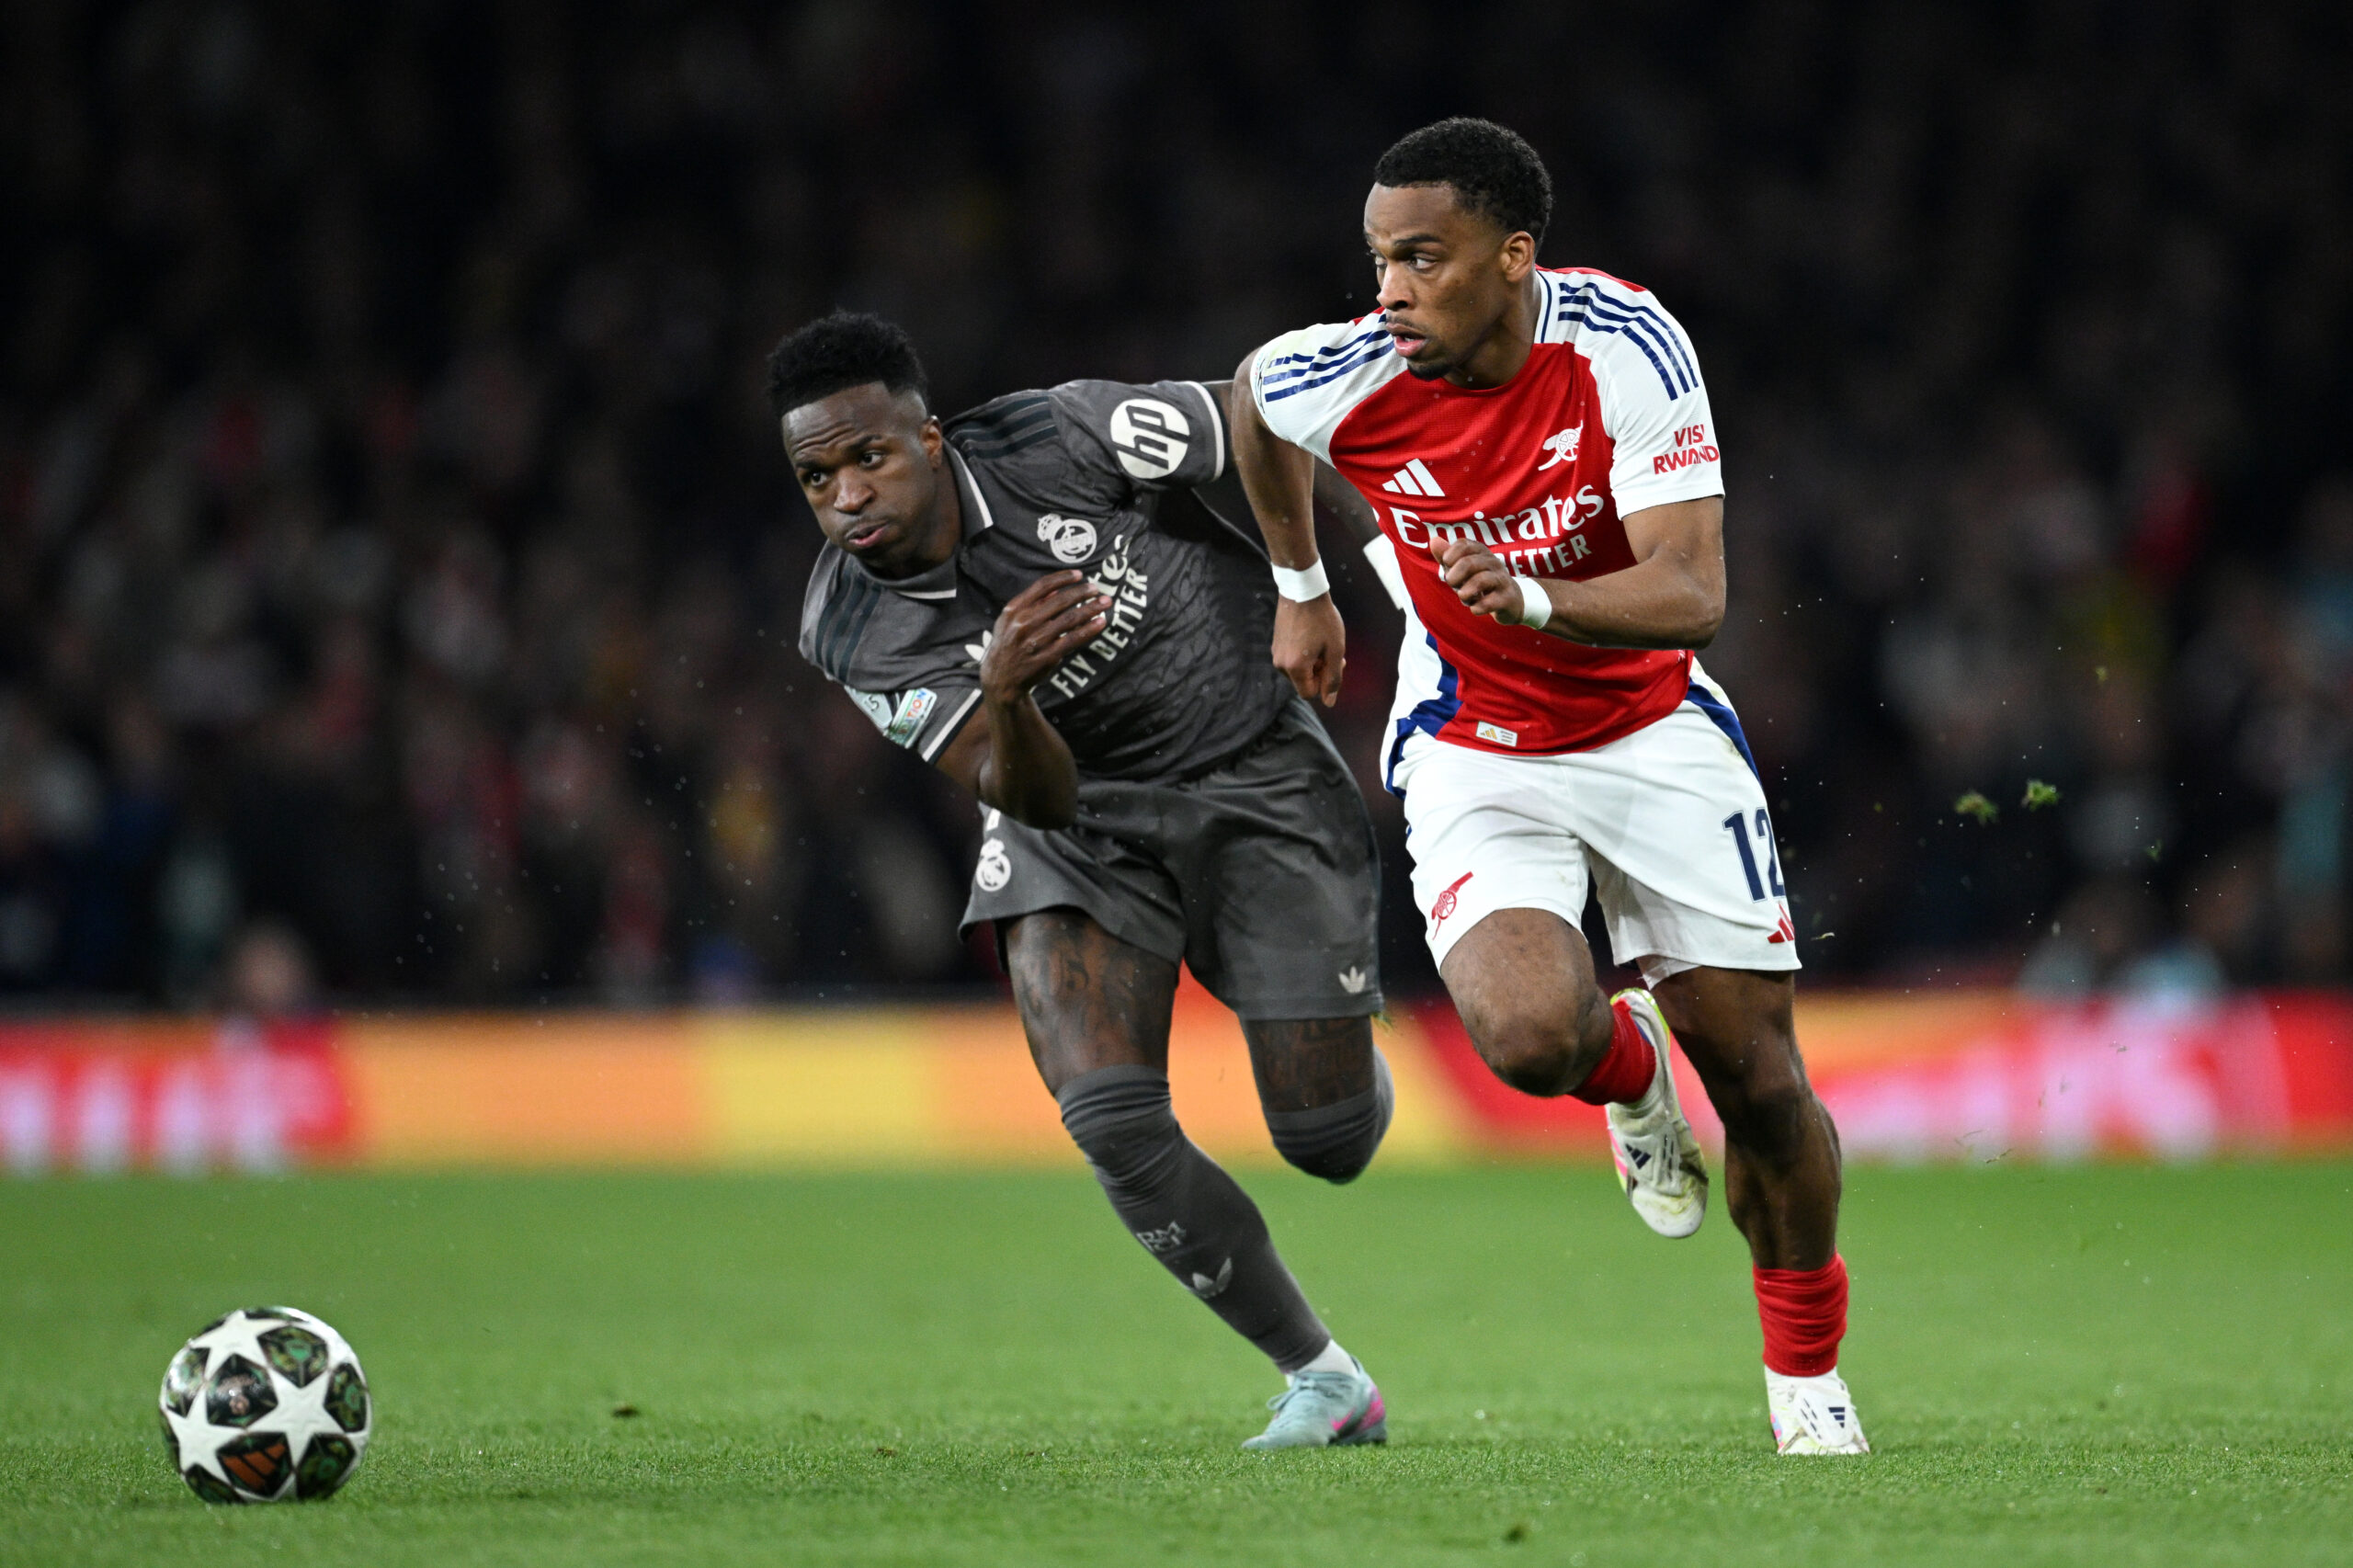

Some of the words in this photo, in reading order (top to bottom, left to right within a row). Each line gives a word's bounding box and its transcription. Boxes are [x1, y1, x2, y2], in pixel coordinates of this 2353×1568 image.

[1110, 400, 1190, 478] hp
[1389, 484, 1605, 549] Emirates
[1050, 654, 1097, 699] FLY
[1088, 567, 1148, 662] BETTER
[1722, 807, 1787, 903] 12
